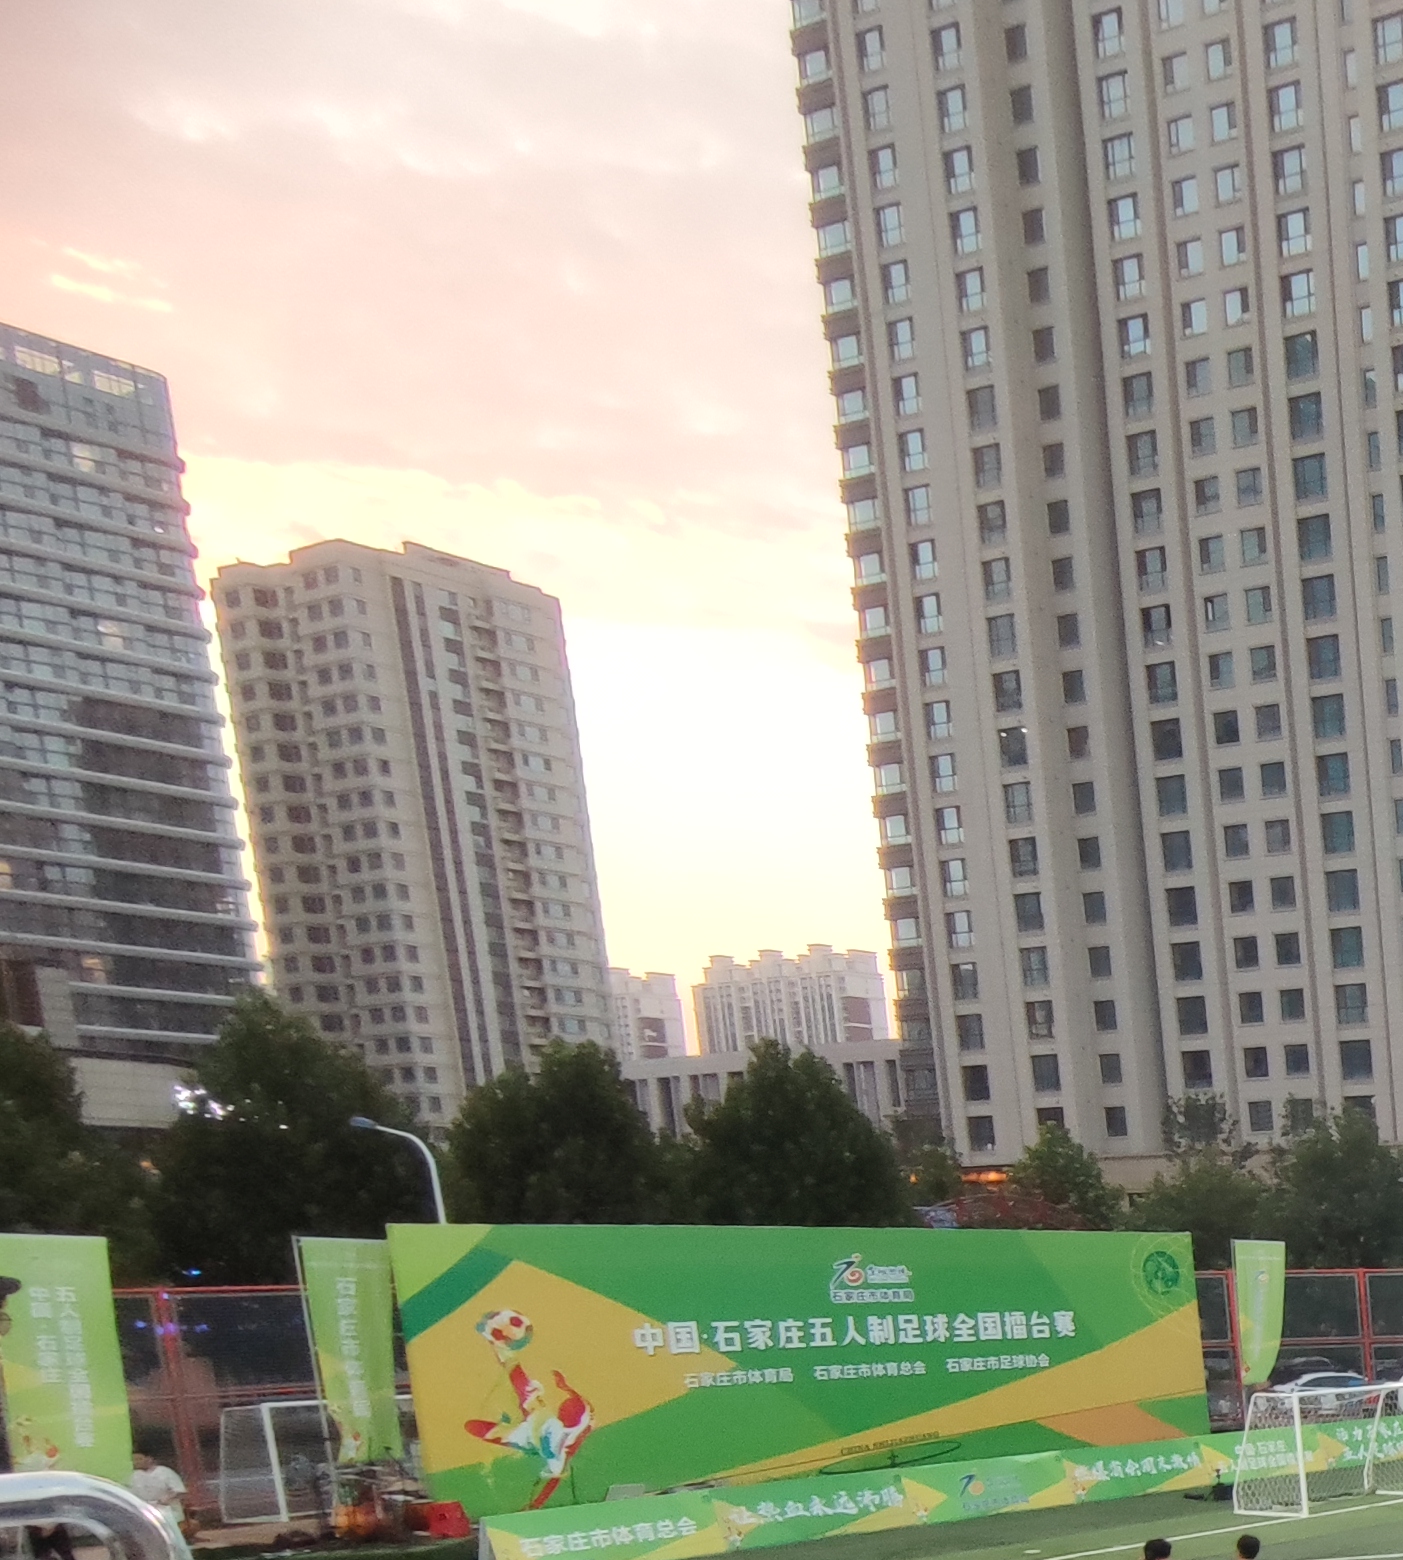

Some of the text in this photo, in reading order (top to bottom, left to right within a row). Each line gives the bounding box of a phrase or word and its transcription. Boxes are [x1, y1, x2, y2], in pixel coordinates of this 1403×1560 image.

[633, 1310, 1078, 1356] 中国·石家庄五人制足球全国擂台赛
[813, 1360, 927, 1382] 石家庄市体育总会
[946, 1353, 1051, 1375] 石家庄市足球协会
[684, 1366, 794, 1389] 石家庄市体育局
[520, 1517, 698, 1558] 石家庄市体育总会
